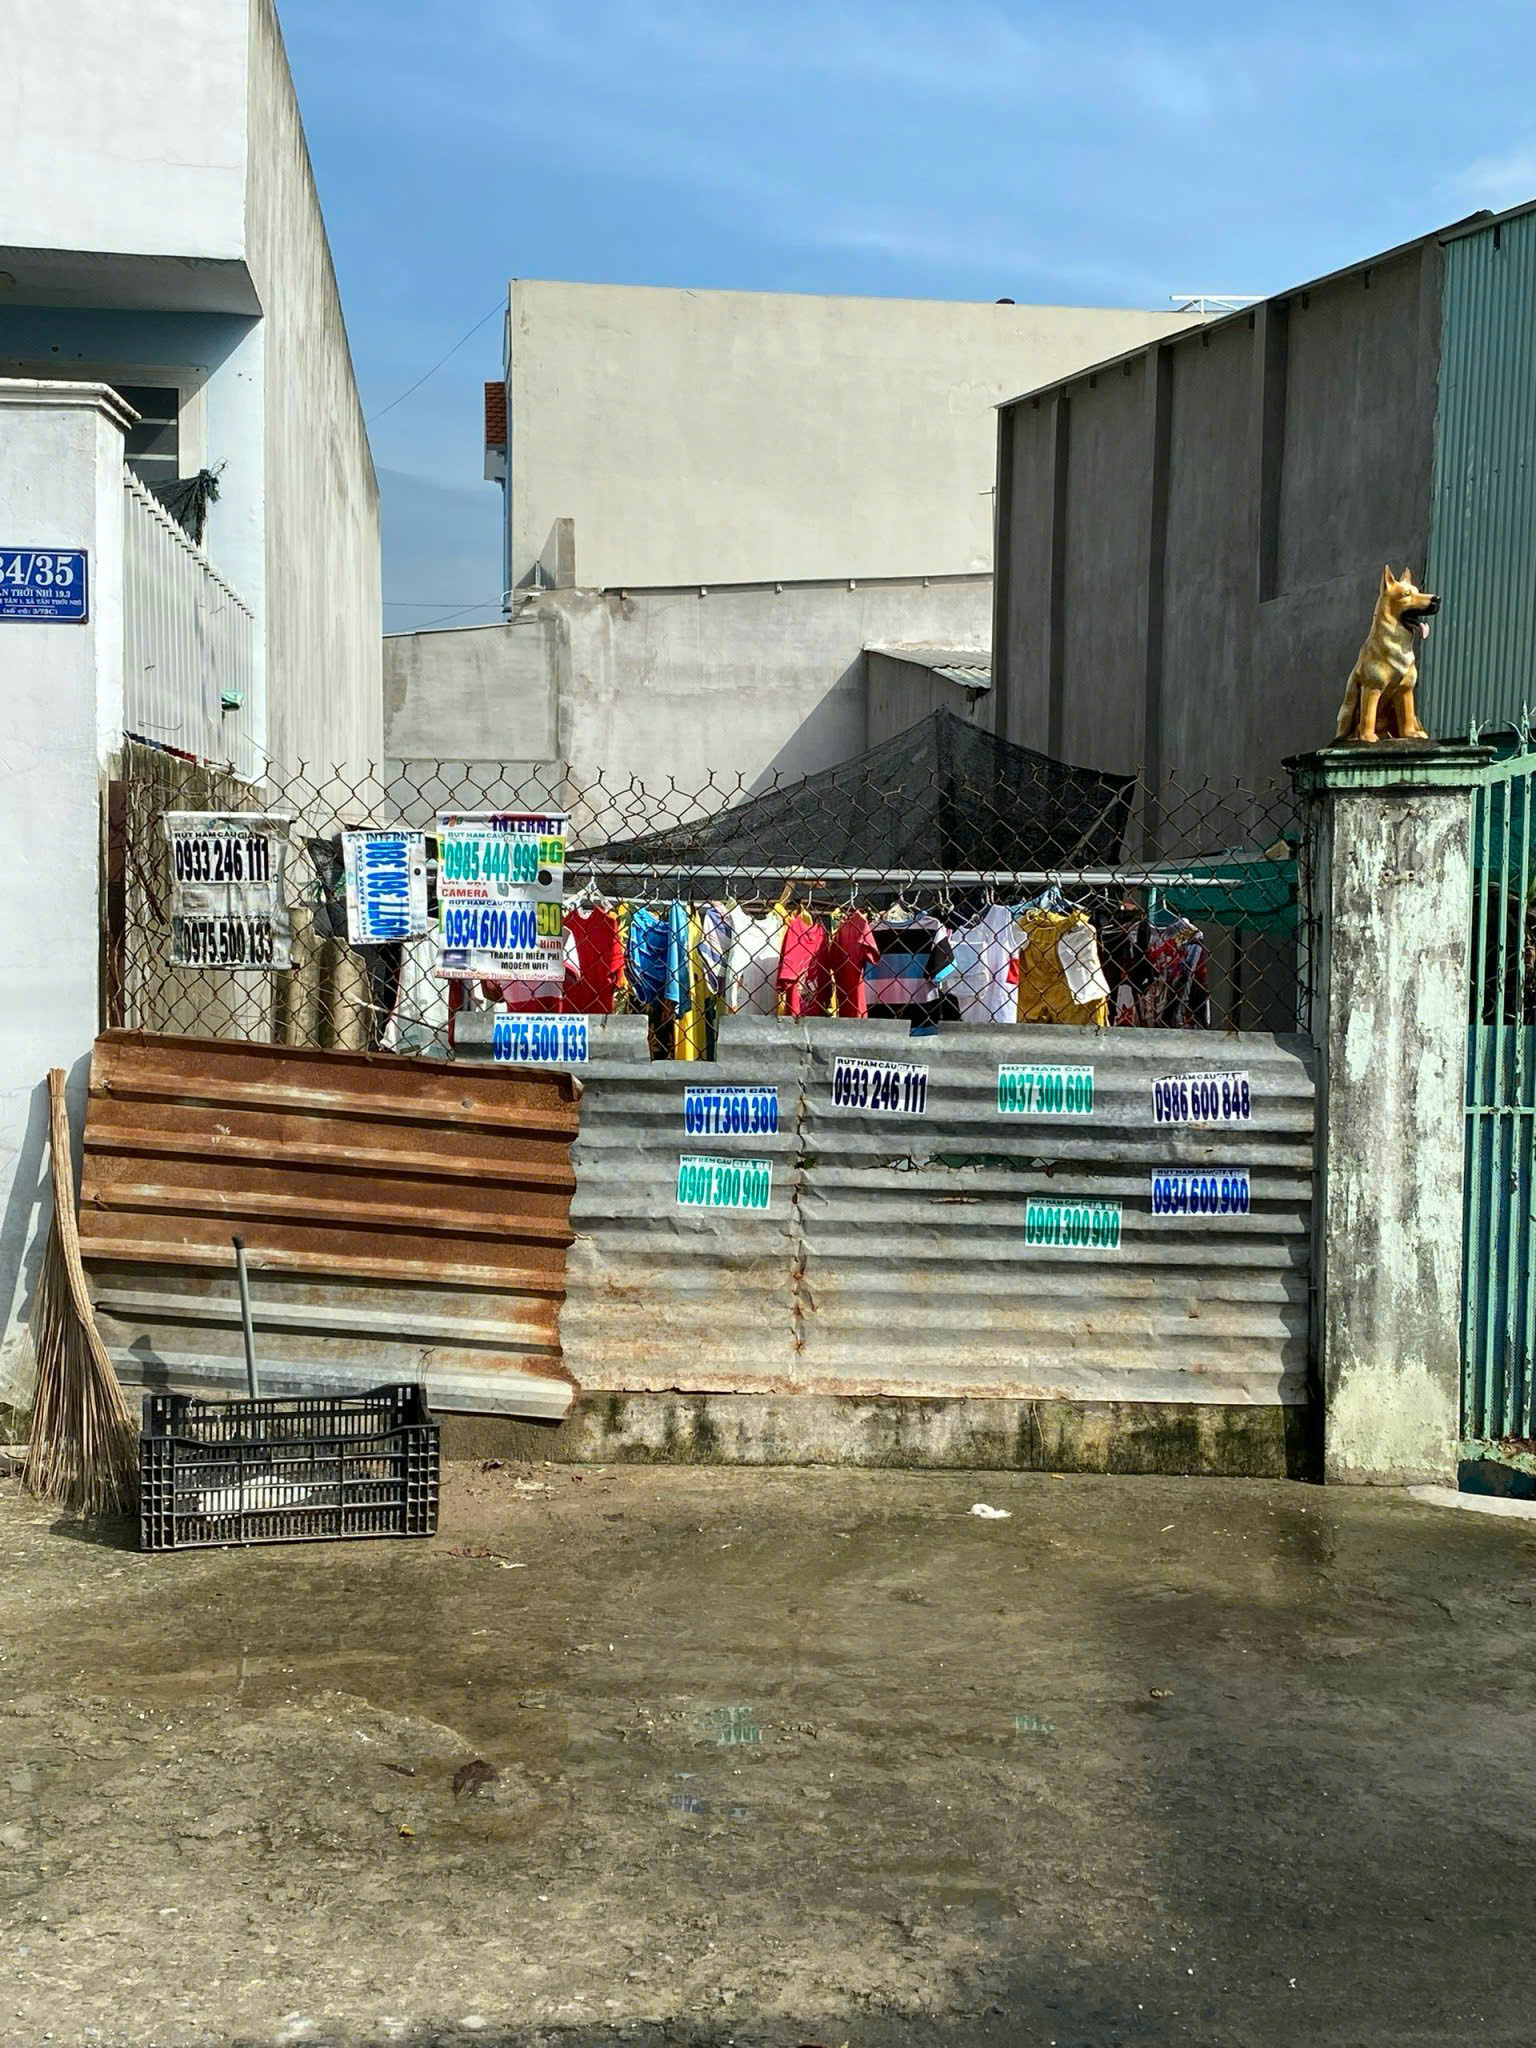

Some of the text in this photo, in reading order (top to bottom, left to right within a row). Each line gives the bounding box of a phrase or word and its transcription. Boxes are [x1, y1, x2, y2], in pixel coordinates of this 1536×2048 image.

[0, 555, 74, 586] 4/35
[492, 817, 564, 835] INTERNET
[176, 839, 269, 881] 0933.246.111
[445, 842, 538, 882] 0985.444.999
[365, 842, 410, 936] 0977.360.380
[441, 889, 488, 897] CAMERA
[183, 922, 273, 963] 0975.500.133
[446, 909, 536, 949] 0934.600.900
[490, 951, 513, 959] TRANG
[501, 962, 548, 970] MODEM WIFI
[494, 1023, 587, 1061] 0975.500.133
[835, 1066, 927, 1113] 0933.246.111
[999, 1074, 1092, 1113] 0937.300.600
[1155, 1080, 1249, 1122] 0986.600.848
[686, 1096, 778, 1133] 0977.360.380
[679, 1165, 769, 1208] 0901.300.900
[1153, 1178, 1249, 1214] 0934.600.900
[1027, 1206, 1119, 1248] 0901.300.900
